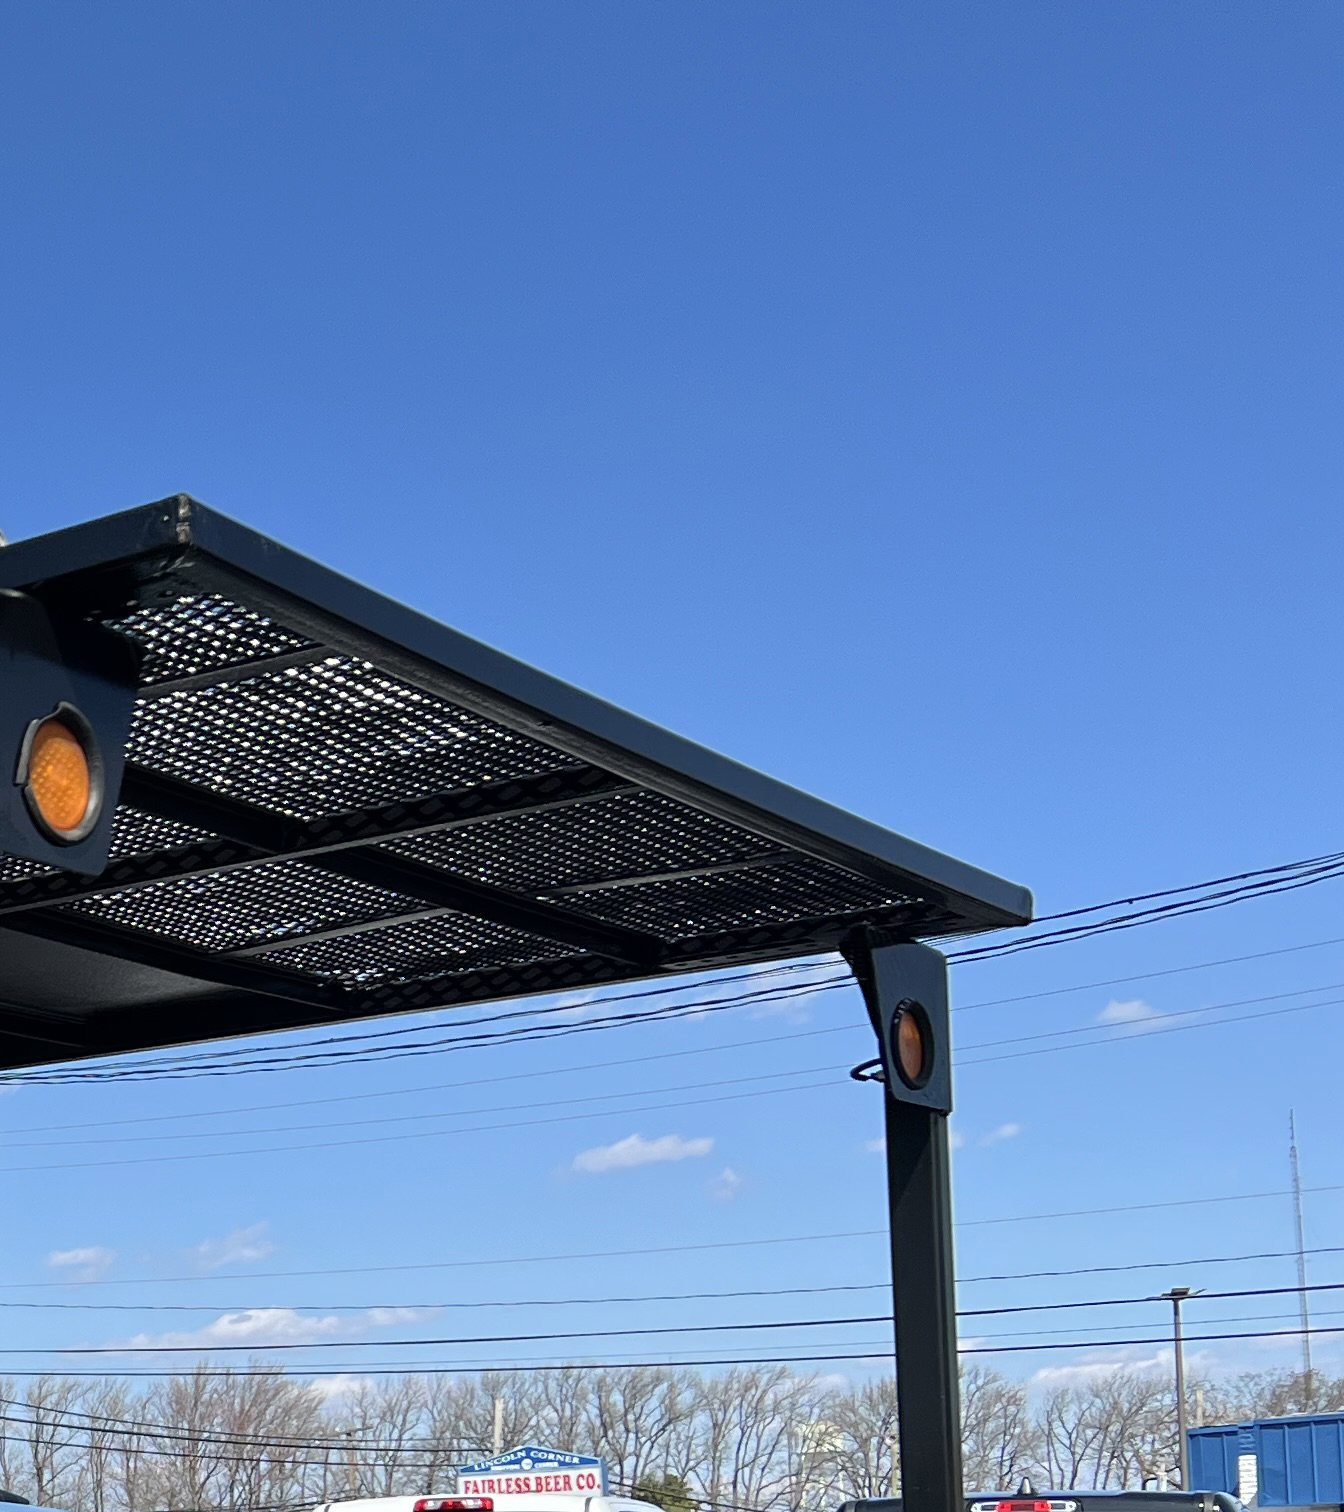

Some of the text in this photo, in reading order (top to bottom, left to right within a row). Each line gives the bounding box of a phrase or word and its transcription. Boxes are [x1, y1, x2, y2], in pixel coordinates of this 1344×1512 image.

[474, 1450, 581, 1471] LINCOLN CORNER
[463, 1472, 602, 1495] FAIRLESS BEER CO.
